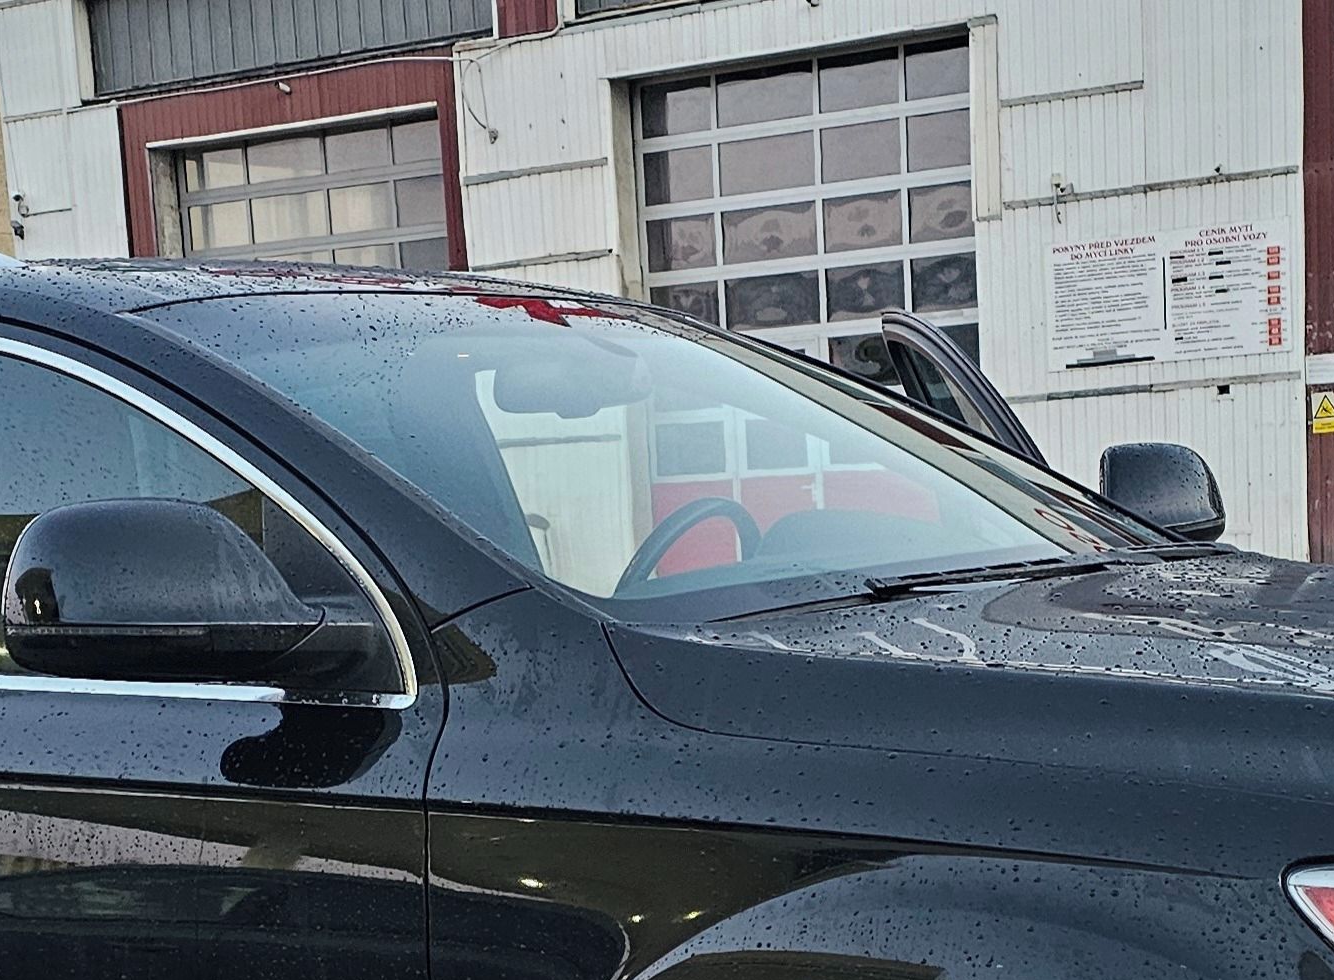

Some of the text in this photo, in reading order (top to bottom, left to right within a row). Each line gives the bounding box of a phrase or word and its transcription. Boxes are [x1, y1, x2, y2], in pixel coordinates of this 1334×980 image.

[1199, 227, 1227, 237] CENÍK
[1184, 231, 1268, 248] PRO OSOBNÍ VOZY
